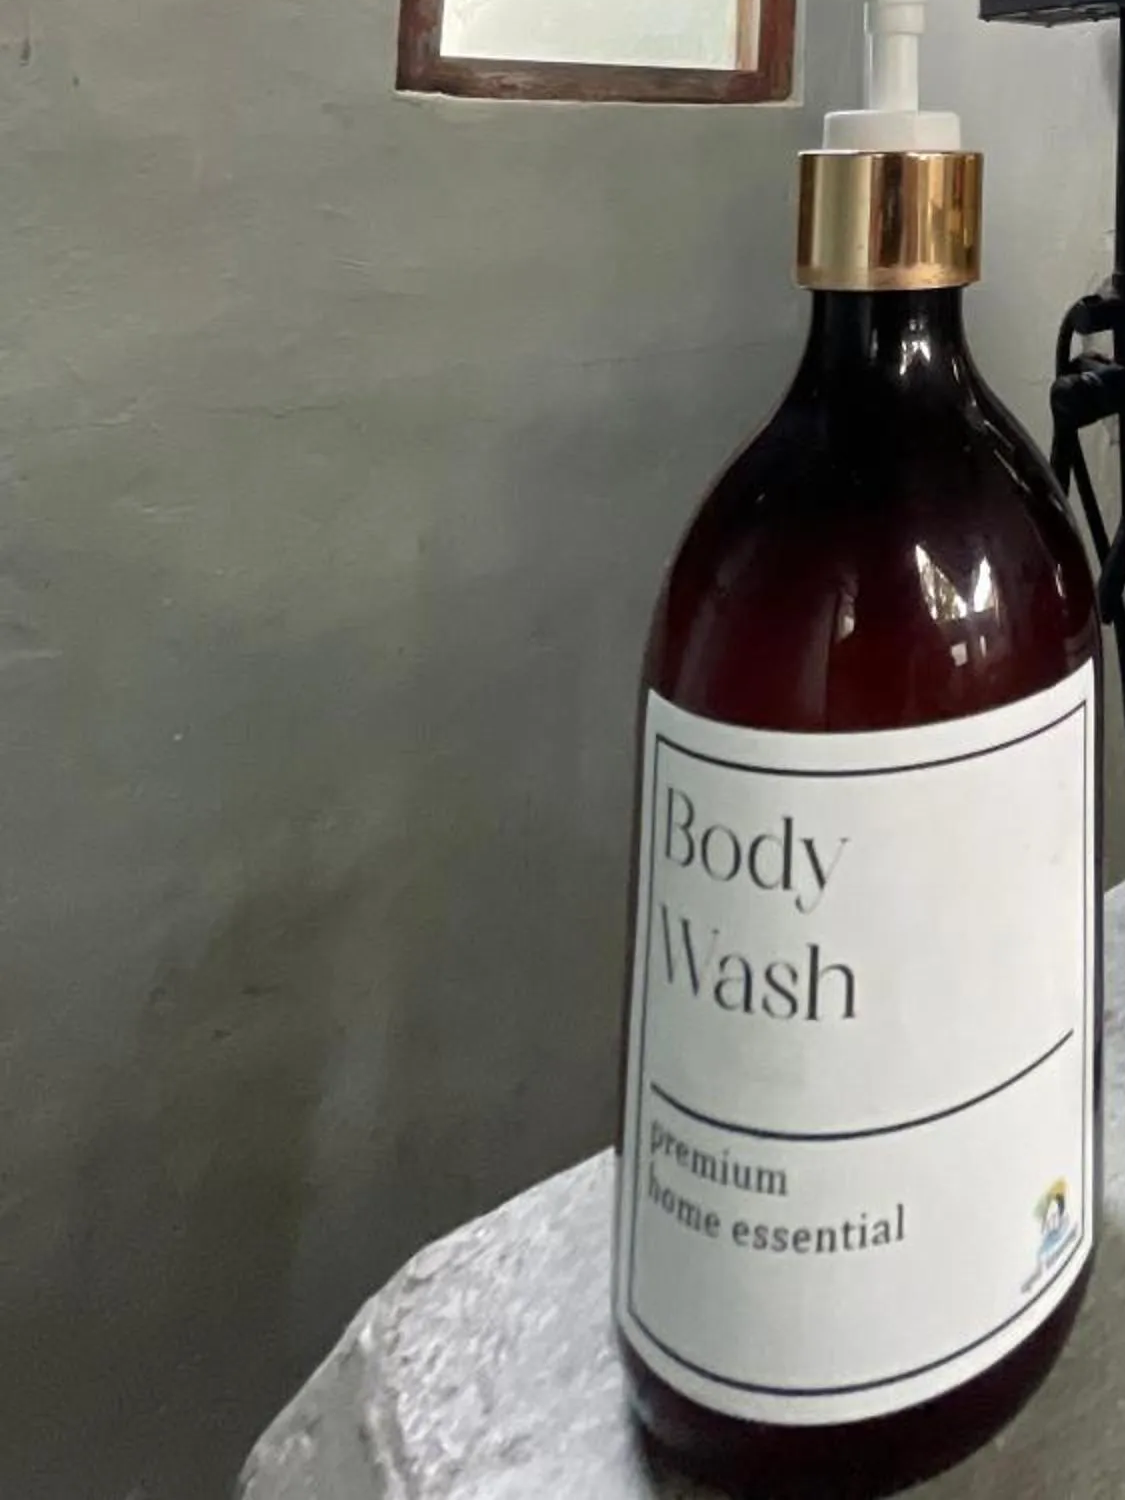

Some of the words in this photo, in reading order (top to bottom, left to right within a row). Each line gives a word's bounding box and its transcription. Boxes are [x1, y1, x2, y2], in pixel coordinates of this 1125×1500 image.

[664, 787, 849, 913] Body
[658, 904, 857, 1021] Wash
[648, 1162, 721, 1239] home
[731, 1201, 906, 1255] essential
[650, 1119, 789, 1197] premium
